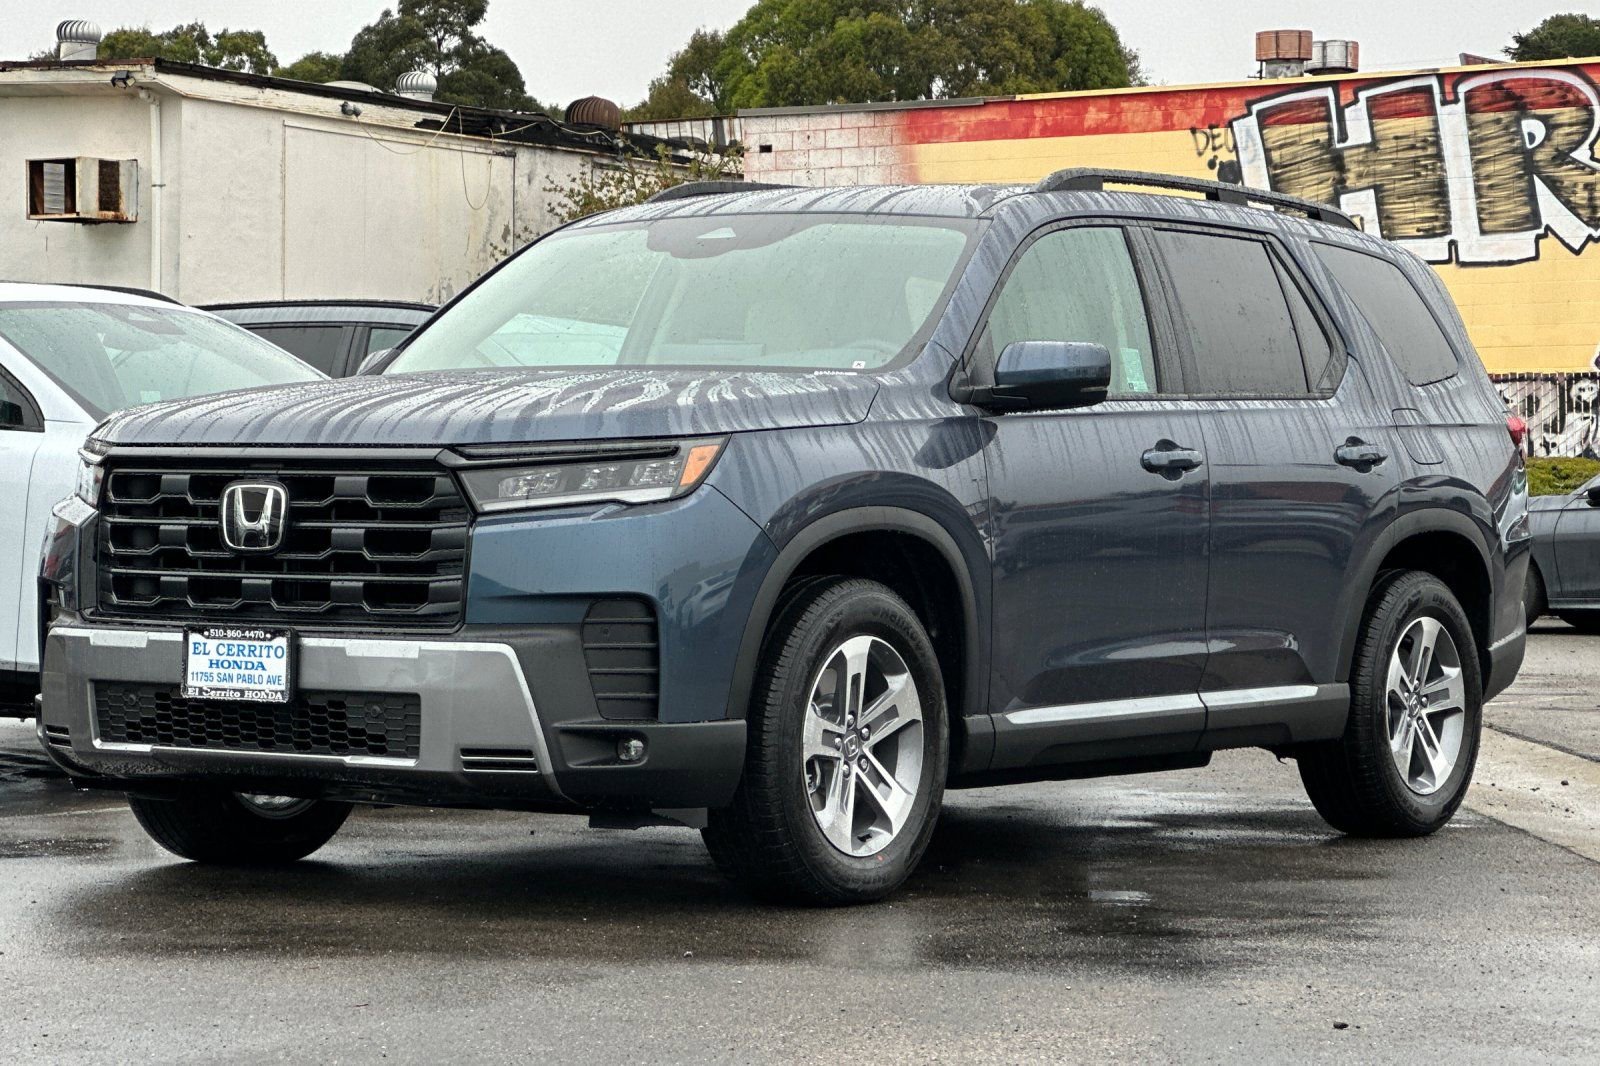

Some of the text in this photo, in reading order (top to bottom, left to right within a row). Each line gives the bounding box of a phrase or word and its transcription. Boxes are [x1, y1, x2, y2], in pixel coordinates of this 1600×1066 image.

[210, 629, 265, 639] 510-860-4470
[192, 641, 285, 659] EL CERRITO
[208, 659, 267, 671] HONDA
[191, 671, 214, 682] 11755
[217, 672, 234, 683] SAN
[236, 673, 264, 685] PABLO
[187, 687, 199, 696] El
[243, 689, 283, 700] HONDA
